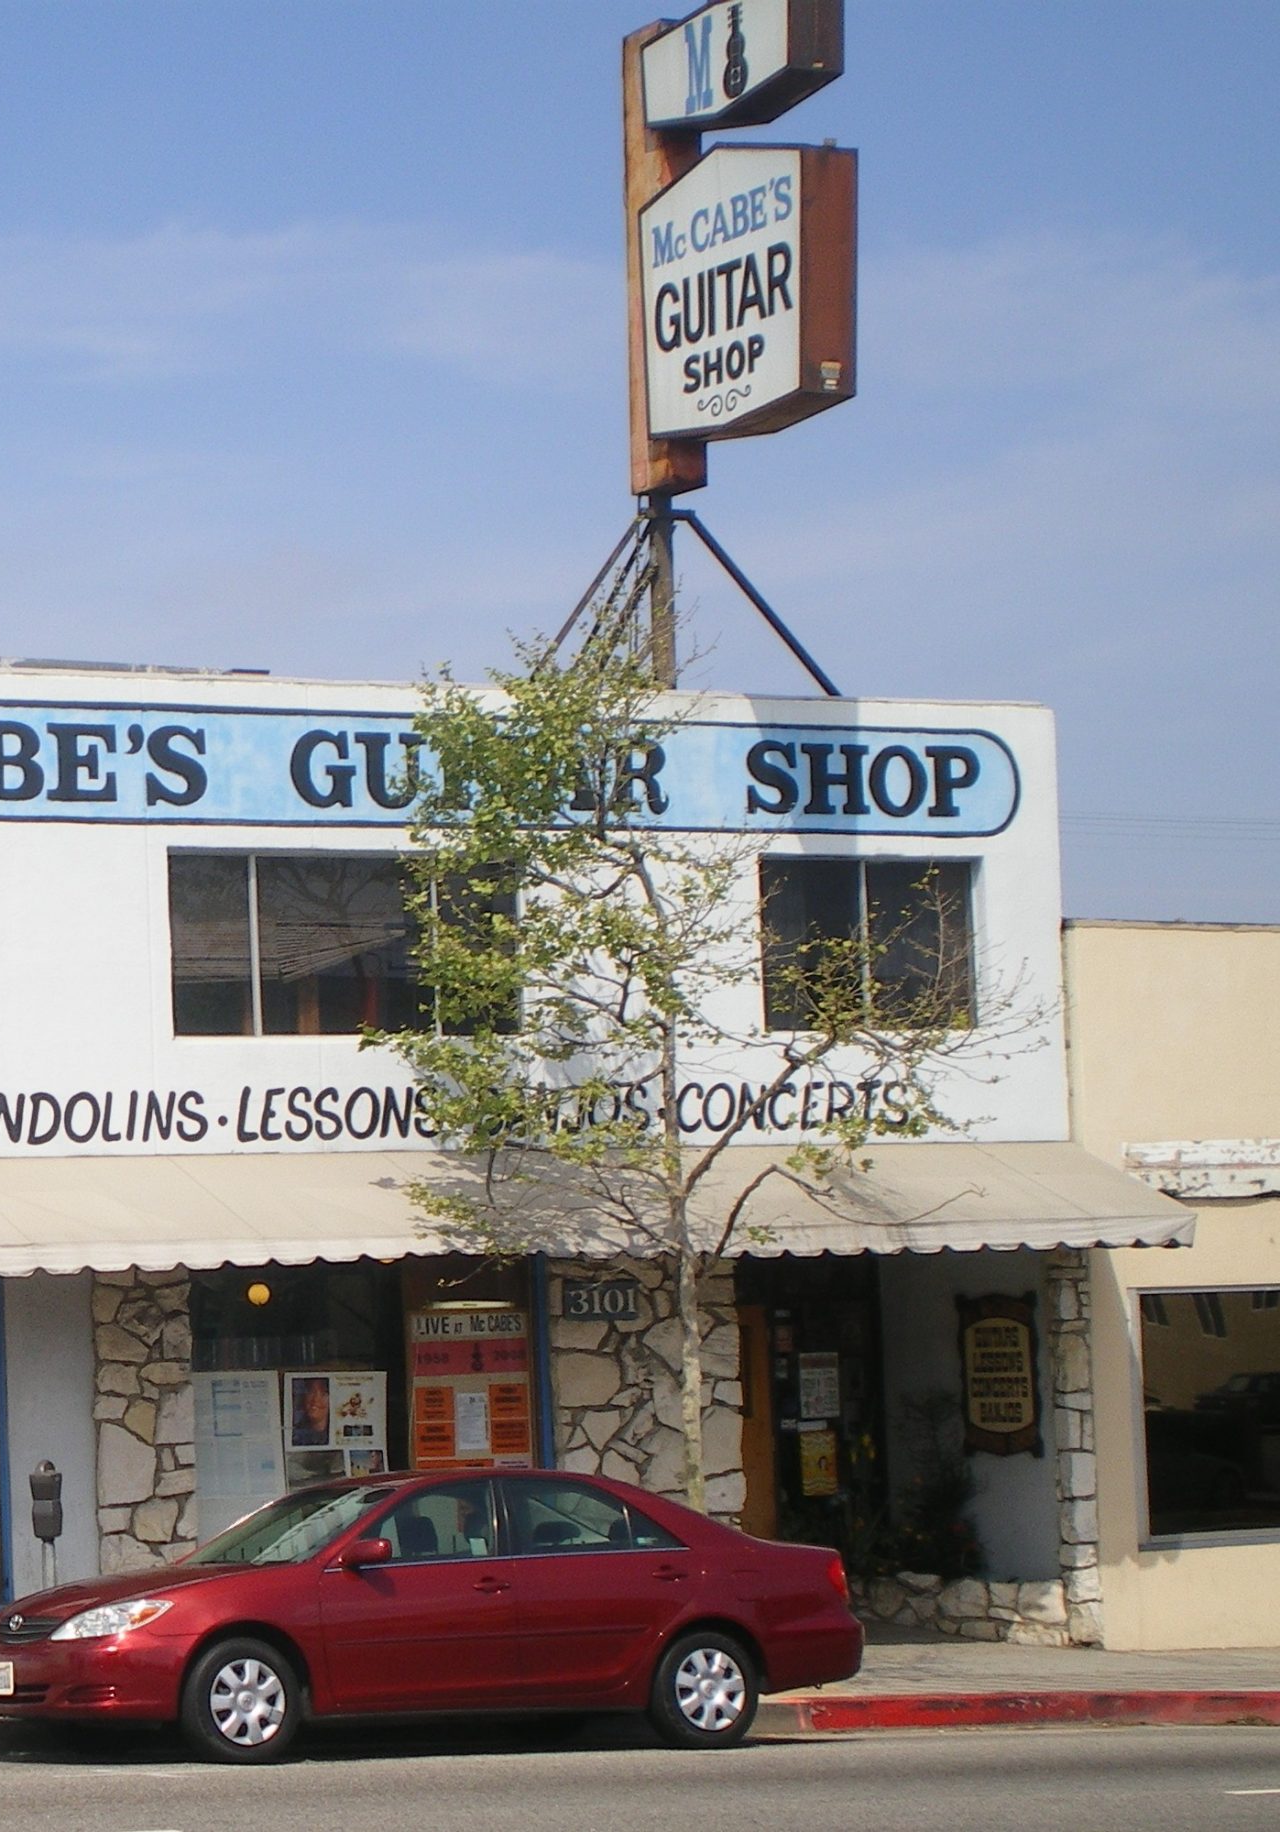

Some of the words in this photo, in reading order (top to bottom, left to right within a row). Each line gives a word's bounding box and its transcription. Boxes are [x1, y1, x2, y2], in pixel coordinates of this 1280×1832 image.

[684, 14, 713, 115] M
[652, 174, 793, 269] McCABE'S
[655, 241, 794, 353] GUITAR
[683, 333, 765, 394] SHOP
[290, 729, 670, 815] GUR
[747, 739, 981, 818] SHOP
[236, 1085, 439, 1144] LESSONS
[677, 1080, 909, 1134] CONCERTS
[417, 1316, 450, 1336] LIVE
[568, 1287, 638, 1315] 3101
